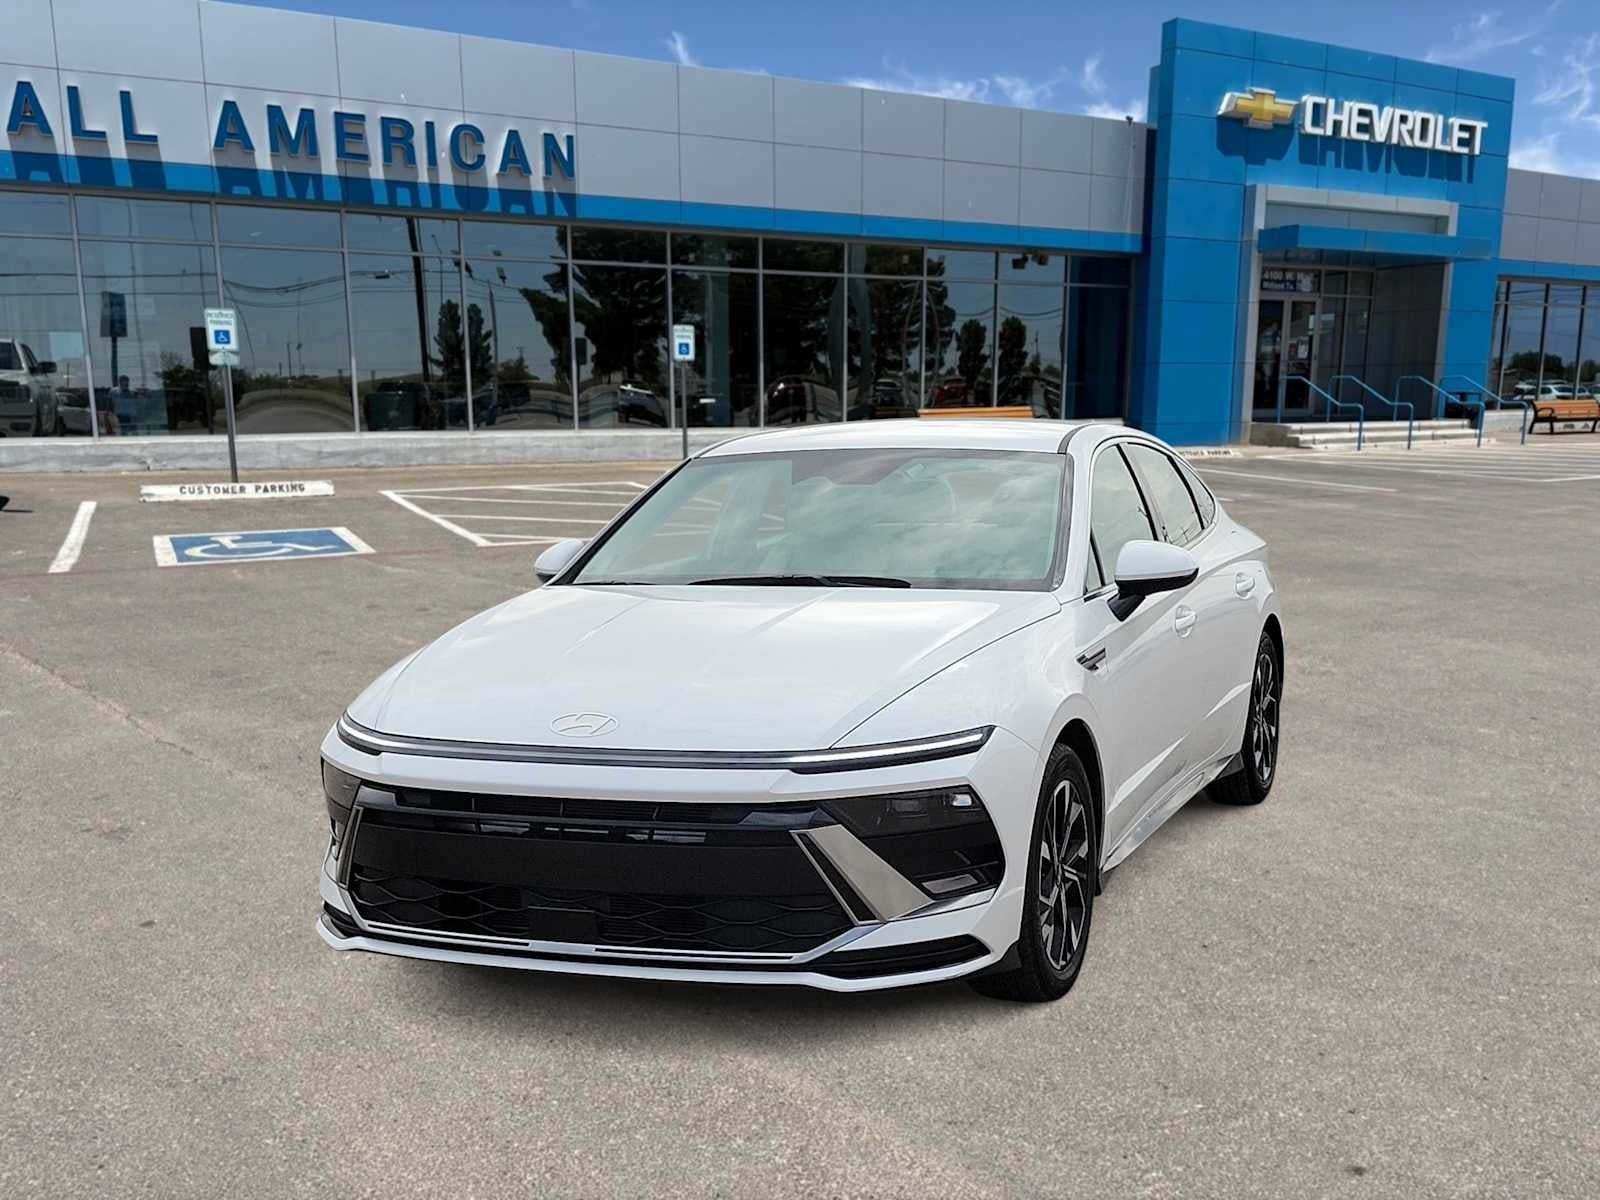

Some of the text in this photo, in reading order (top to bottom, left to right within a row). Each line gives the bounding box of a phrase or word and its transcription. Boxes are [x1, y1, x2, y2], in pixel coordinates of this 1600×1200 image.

[7, 81, 575, 179] ALL AMERICAN
[1300, 94, 1488, 155] CHEVROLET
[179, 483, 306, 495] CUSTOMER PARKING
